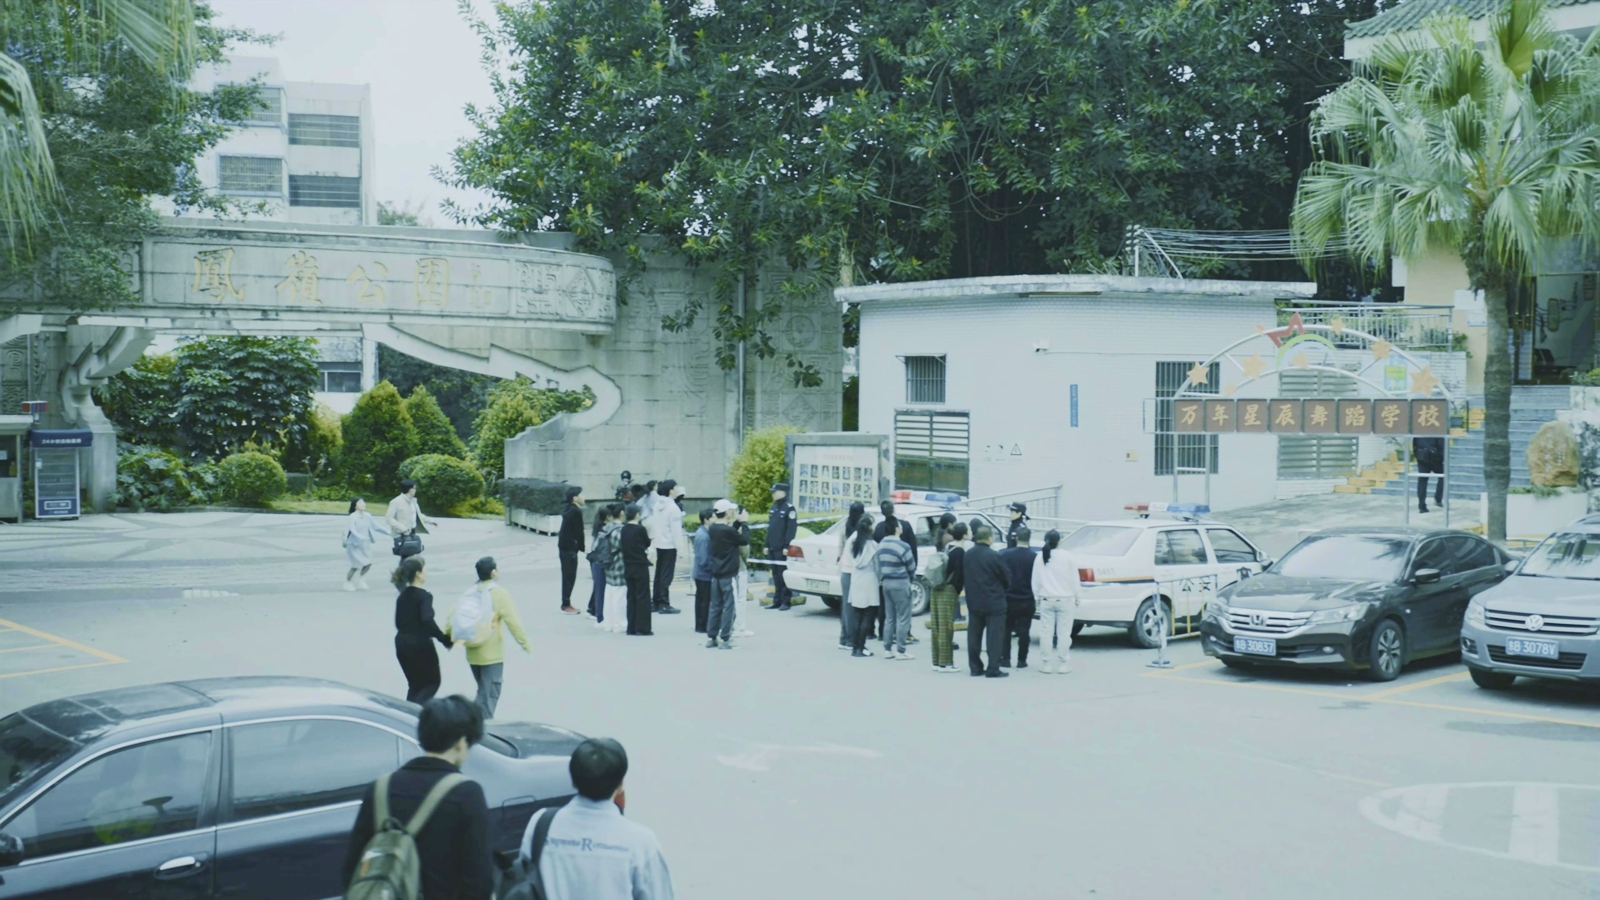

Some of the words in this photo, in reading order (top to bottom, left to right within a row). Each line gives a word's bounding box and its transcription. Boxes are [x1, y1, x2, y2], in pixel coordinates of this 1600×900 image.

[1180, 403, 1441, 428] 万年星辰舞蹈学校
[1178, 573, 1212, 593] 公安
